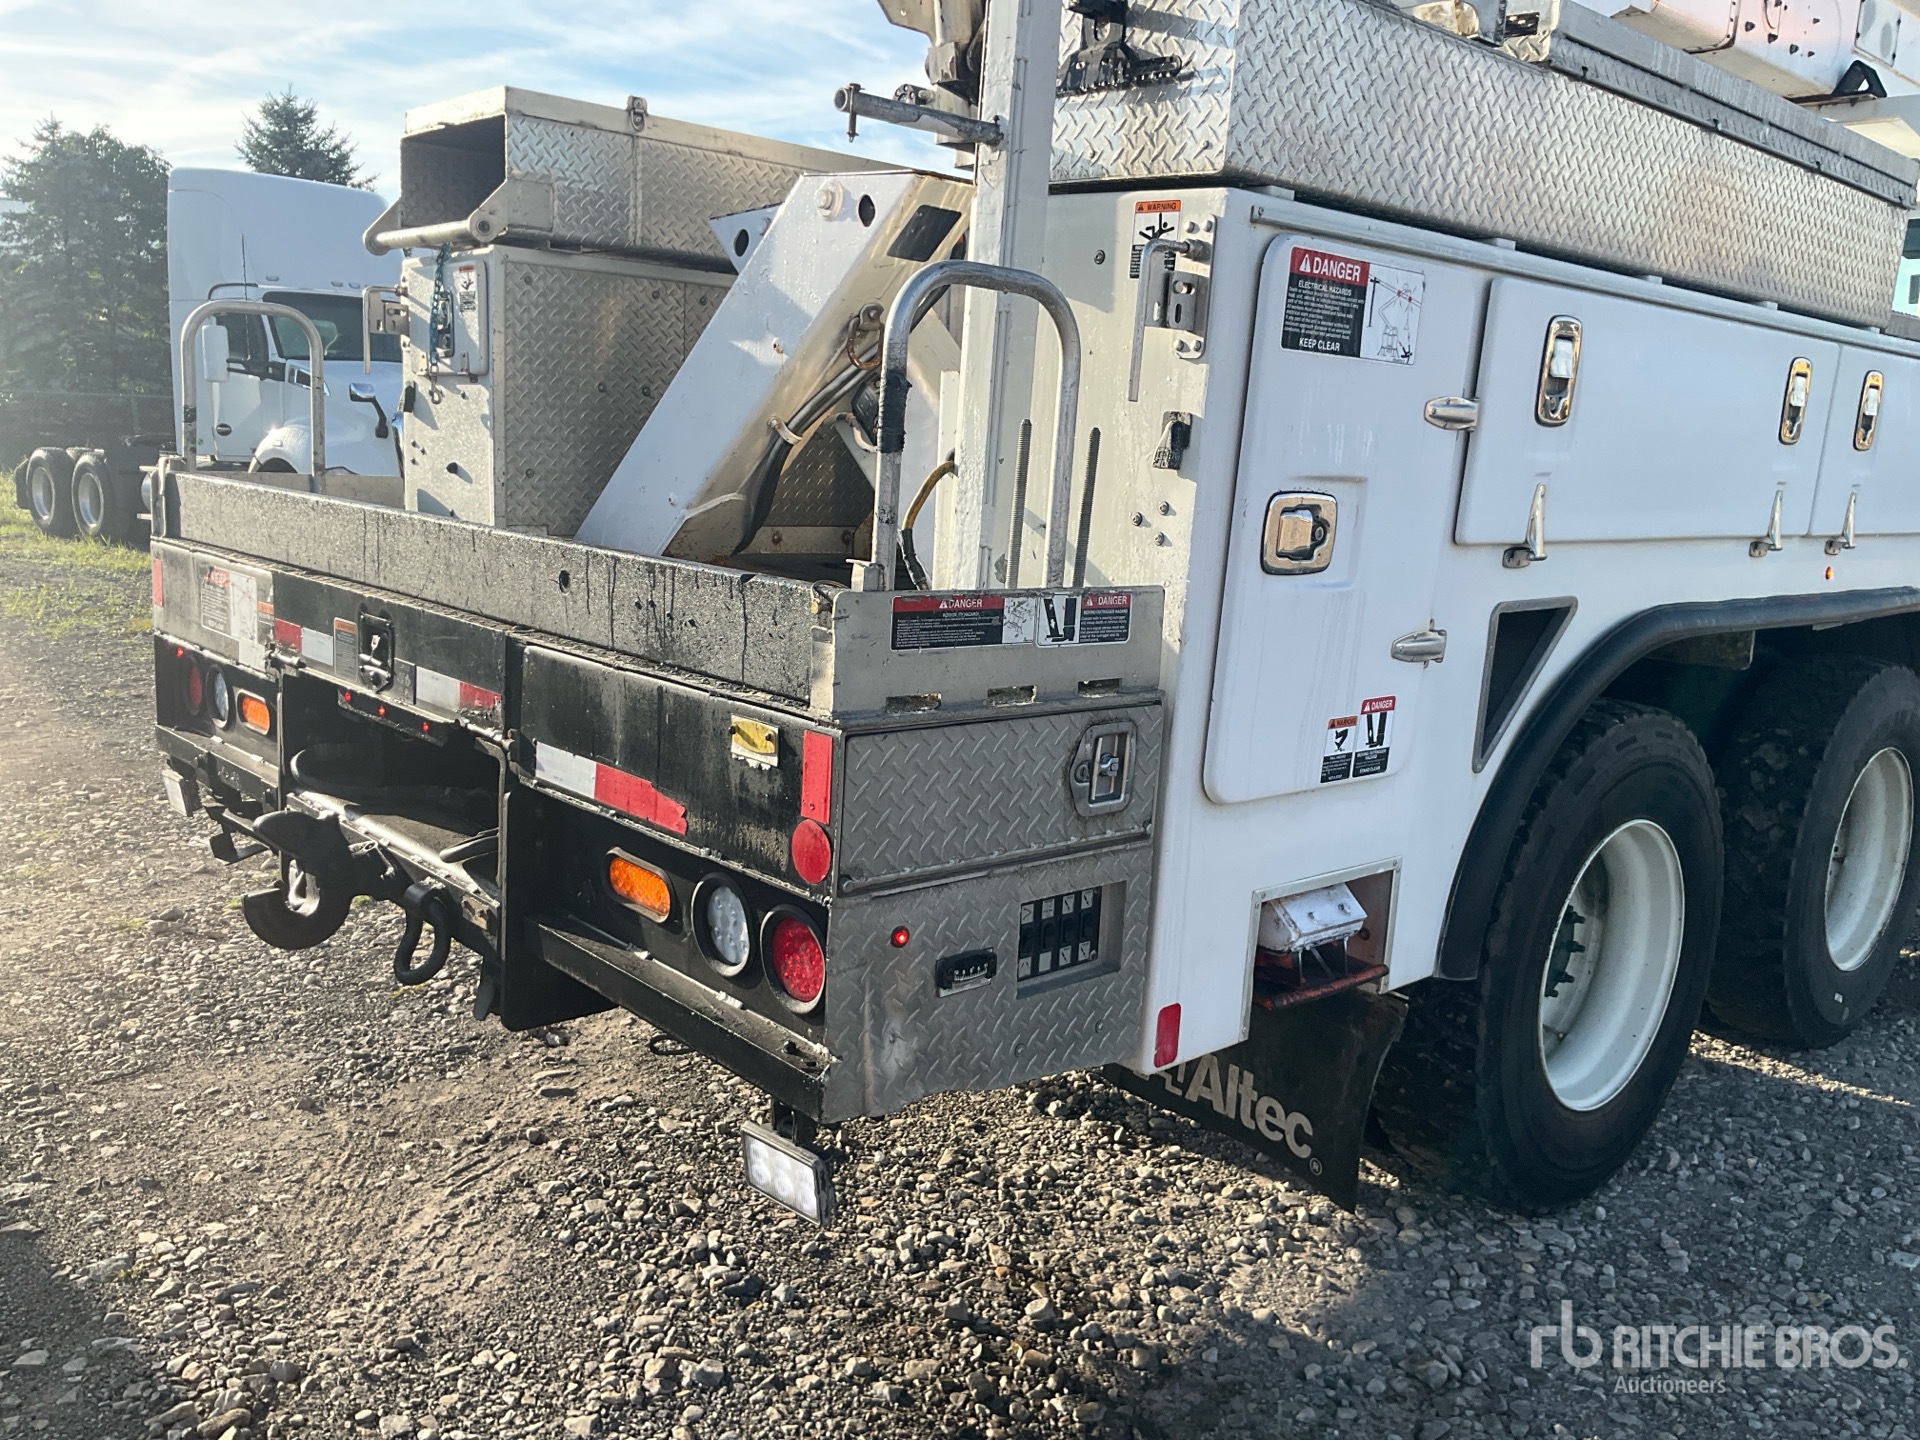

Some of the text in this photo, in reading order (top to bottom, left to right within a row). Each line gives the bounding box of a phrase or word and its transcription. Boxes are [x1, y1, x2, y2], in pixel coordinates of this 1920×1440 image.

[1147, 203, 1177, 211] WARNING
[1312, 257, 1361, 282] DANGER
[1298, 280, 1328, 292] ELECTRICAL
[1329, 286, 1352, 296] HAZARDS
[1298, 337, 1341, 351] KEEP CLEAR
[948, 598, 983, 609] DANGER
[1098, 595, 1128, 606] DANGER
[1371, 699, 1393, 710] DANGER
[1184, 1053, 1314, 1159] Altec
